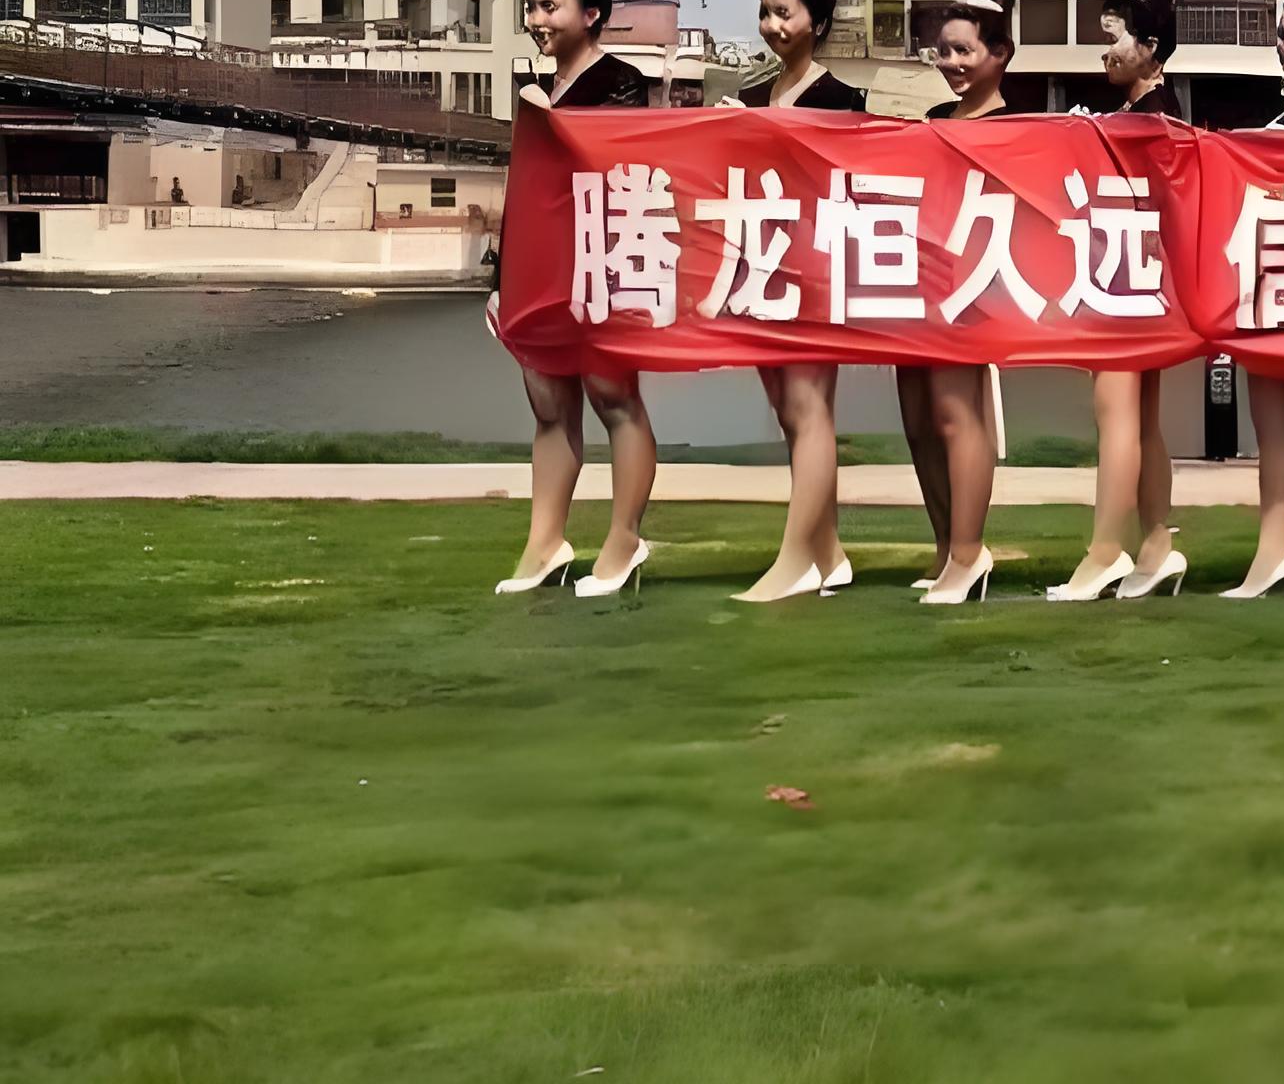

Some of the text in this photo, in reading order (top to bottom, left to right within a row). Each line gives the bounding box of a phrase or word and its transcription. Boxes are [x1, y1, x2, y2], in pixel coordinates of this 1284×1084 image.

[569, 162, 1169, 329] 腾龙恒久远
